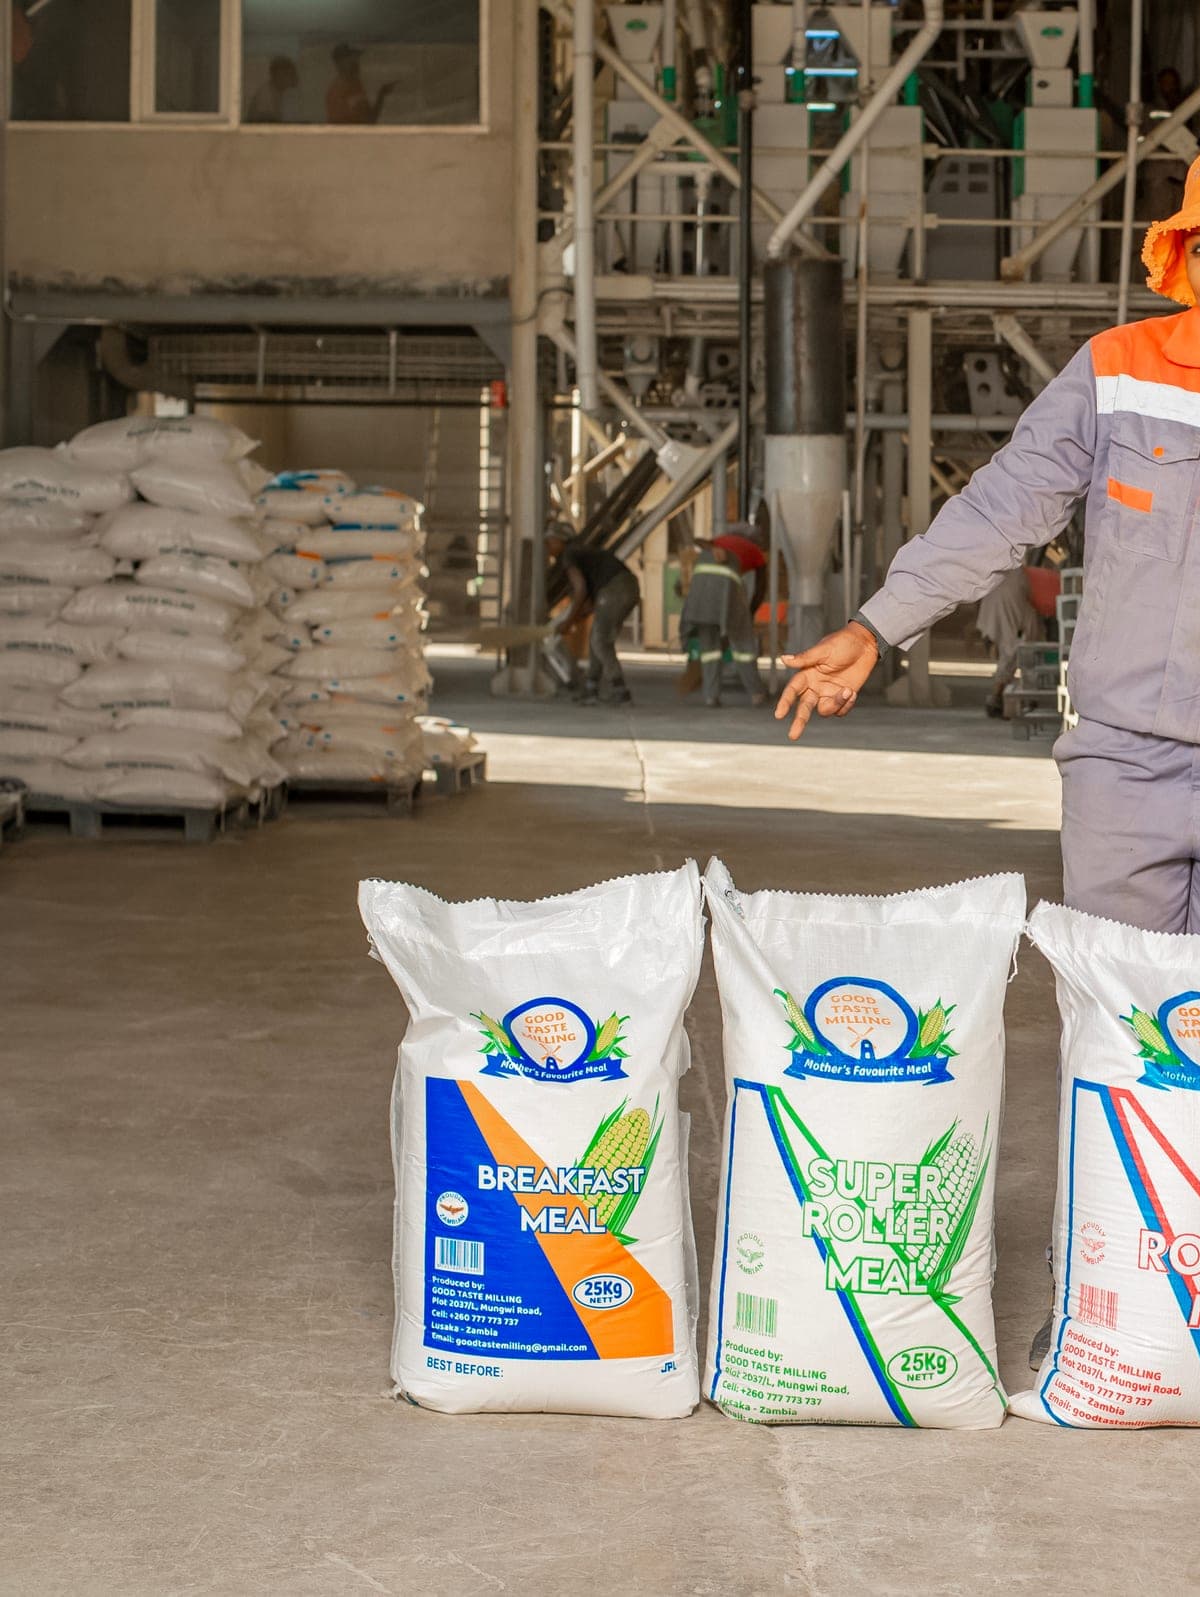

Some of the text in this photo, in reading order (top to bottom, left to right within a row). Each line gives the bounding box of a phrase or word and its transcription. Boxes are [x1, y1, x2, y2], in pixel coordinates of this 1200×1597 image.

[831, 994, 876, 1004] GOOD
[524, 1012, 565, 1024] GOOD
[832, 1005, 880, 1014] TASTE
[525, 1023, 568, 1034] TASTE
[825, 1016, 892, 1025] MILLING
[521, 1033, 576, 1044] MILLING
[541, 1070, 584, 1080] Favourite
[585, 1063, 608, 1074] Meal
[804, 1058, 932, 1076] Mother's Favourite Meal
[478, 1164, 645, 1195] BREAKFAST
[807, 1158, 944, 1203] SUPER
[520, 1206, 607, 1234] MEAL
[802, 1200, 951, 1244] ROLLER
[432, 1276, 485, 1290] Produced by:
[826, 1256, 930, 1295] MEAL
[432, 1286, 522, 1303] GOOD TASTE MILLING
[584, 1281, 623, 1299] 25Kg
[432, 1297, 447, 1306] Plot
[480, 1304, 515, 1314] Mungwi
[517, 1307, 542, 1316] Road,
[432, 1309, 448, 1318] Cell:
[450, 1312, 469, 1321] +260
[472, 1315, 486, 1323] 777
[488, 1316, 502, 1324] 773
[432, 1322, 498, 1336] Lusaka Zambia
[432, 1332, 587, 1353] Email: goodtastemilling@gmail.com
[725, 1340, 783, 1362] Produced by:
[1066, 1329, 1119, 1357] Produced by:
[427, 1357, 504, 1378] BEST BEFORE:
[725, 1354, 827, 1380] GOOD TASTE MILLING
[900, 1352, 947, 1374] 25Kg
[1064, 1344, 1162, 1381] GOOD TASTE MILLING
[906, 1372, 934, 1381] NETT
[1110, 1374, 1151, 1392] Mungwi
[1153, 1385, 1182, 1396] Road,
[722, 1380, 739, 1393] Cell:
[741, 1387, 764, 1399] +260
[767, 1392, 783, 1402] 777
[786, 1396, 802, 1404] 773
[778, 1379, 818, 1392] Mungwi
[821, 1384, 849, 1395] Road,
[1098, 1386, 1152, 1406] 777 773 737
[1048, 1392, 1071, 1412] Email:
[1055, 1378, 1125, 1416] Lusaka Zambia
[760, 1406, 798, 1416] Zambia
